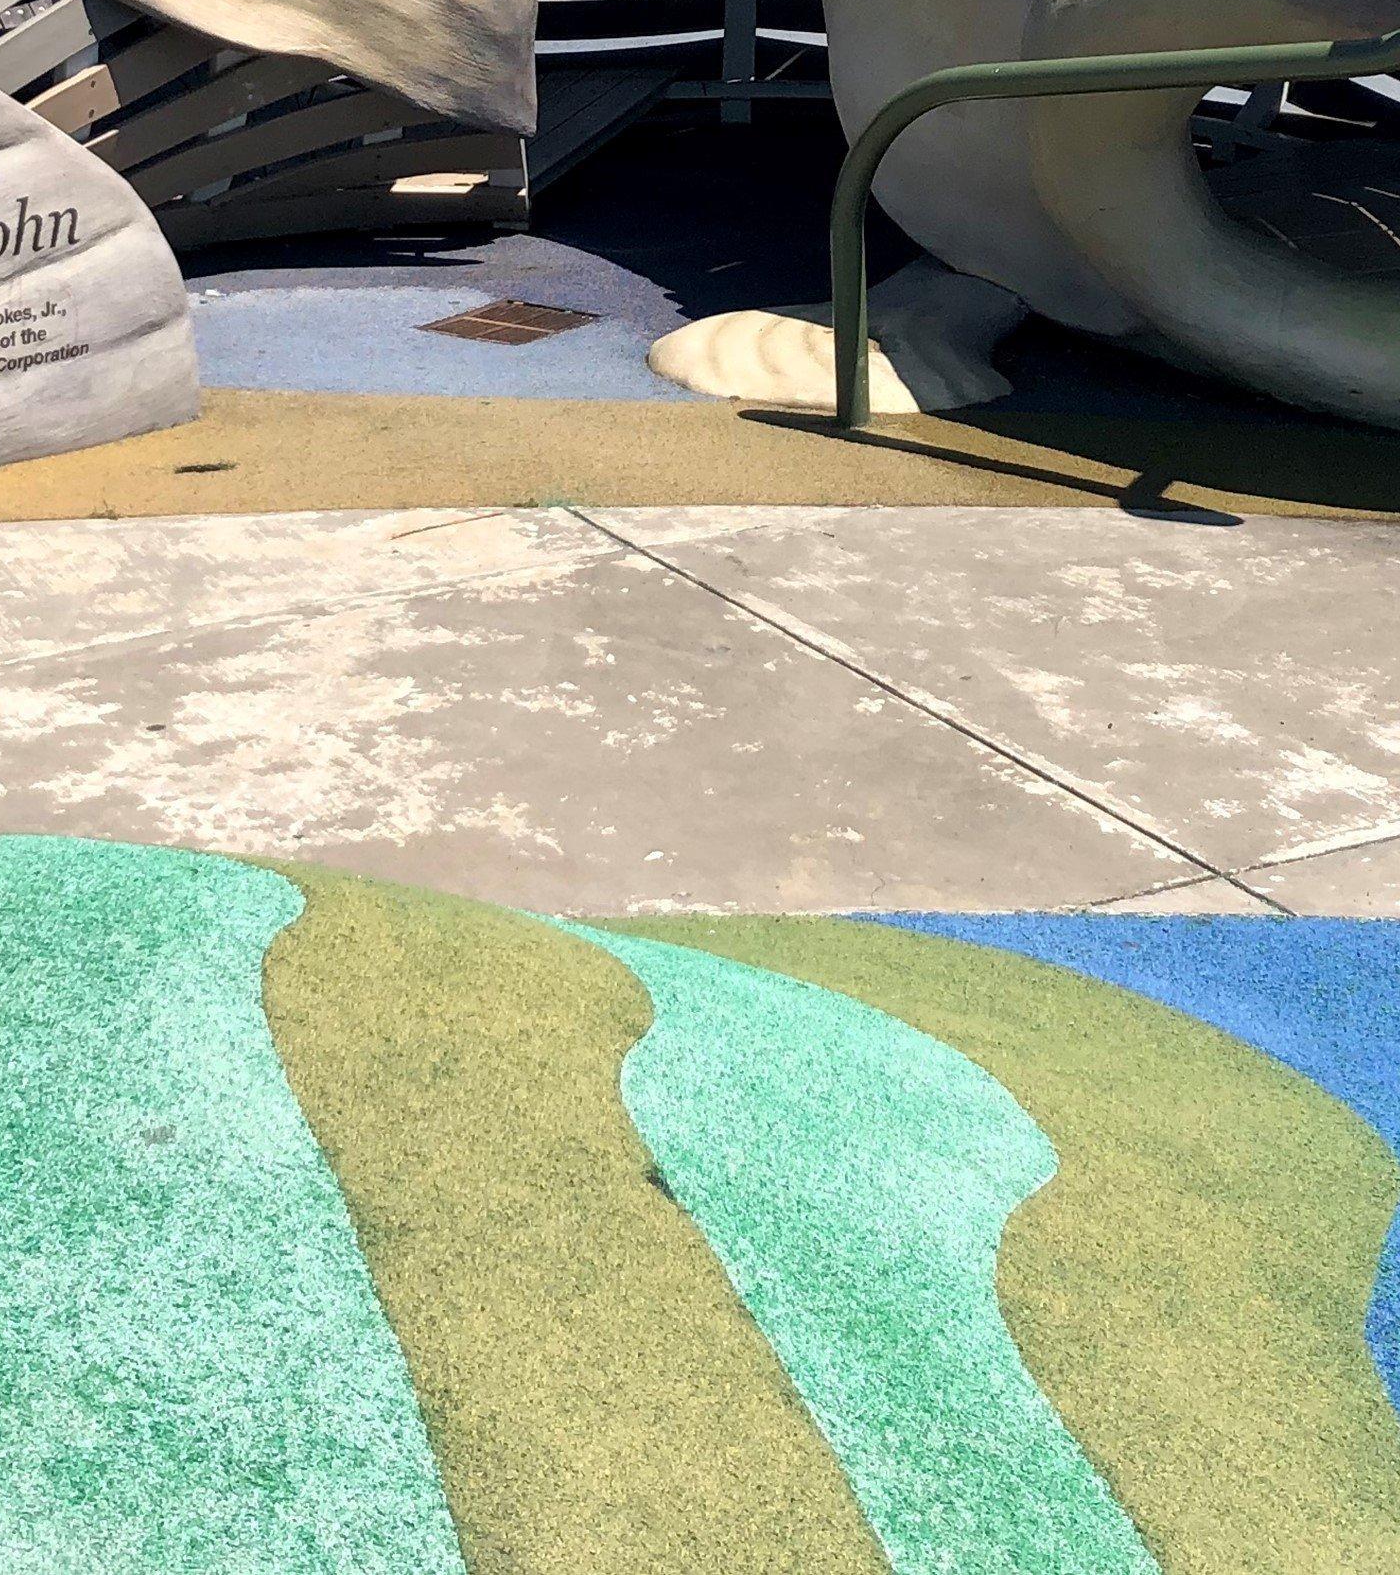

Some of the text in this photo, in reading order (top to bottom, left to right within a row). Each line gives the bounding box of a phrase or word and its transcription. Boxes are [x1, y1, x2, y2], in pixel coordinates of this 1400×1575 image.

[41, 301, 67, 318] Jr.,
[0, 330, 17, 349] of
[20, 327, 48, 345] the
